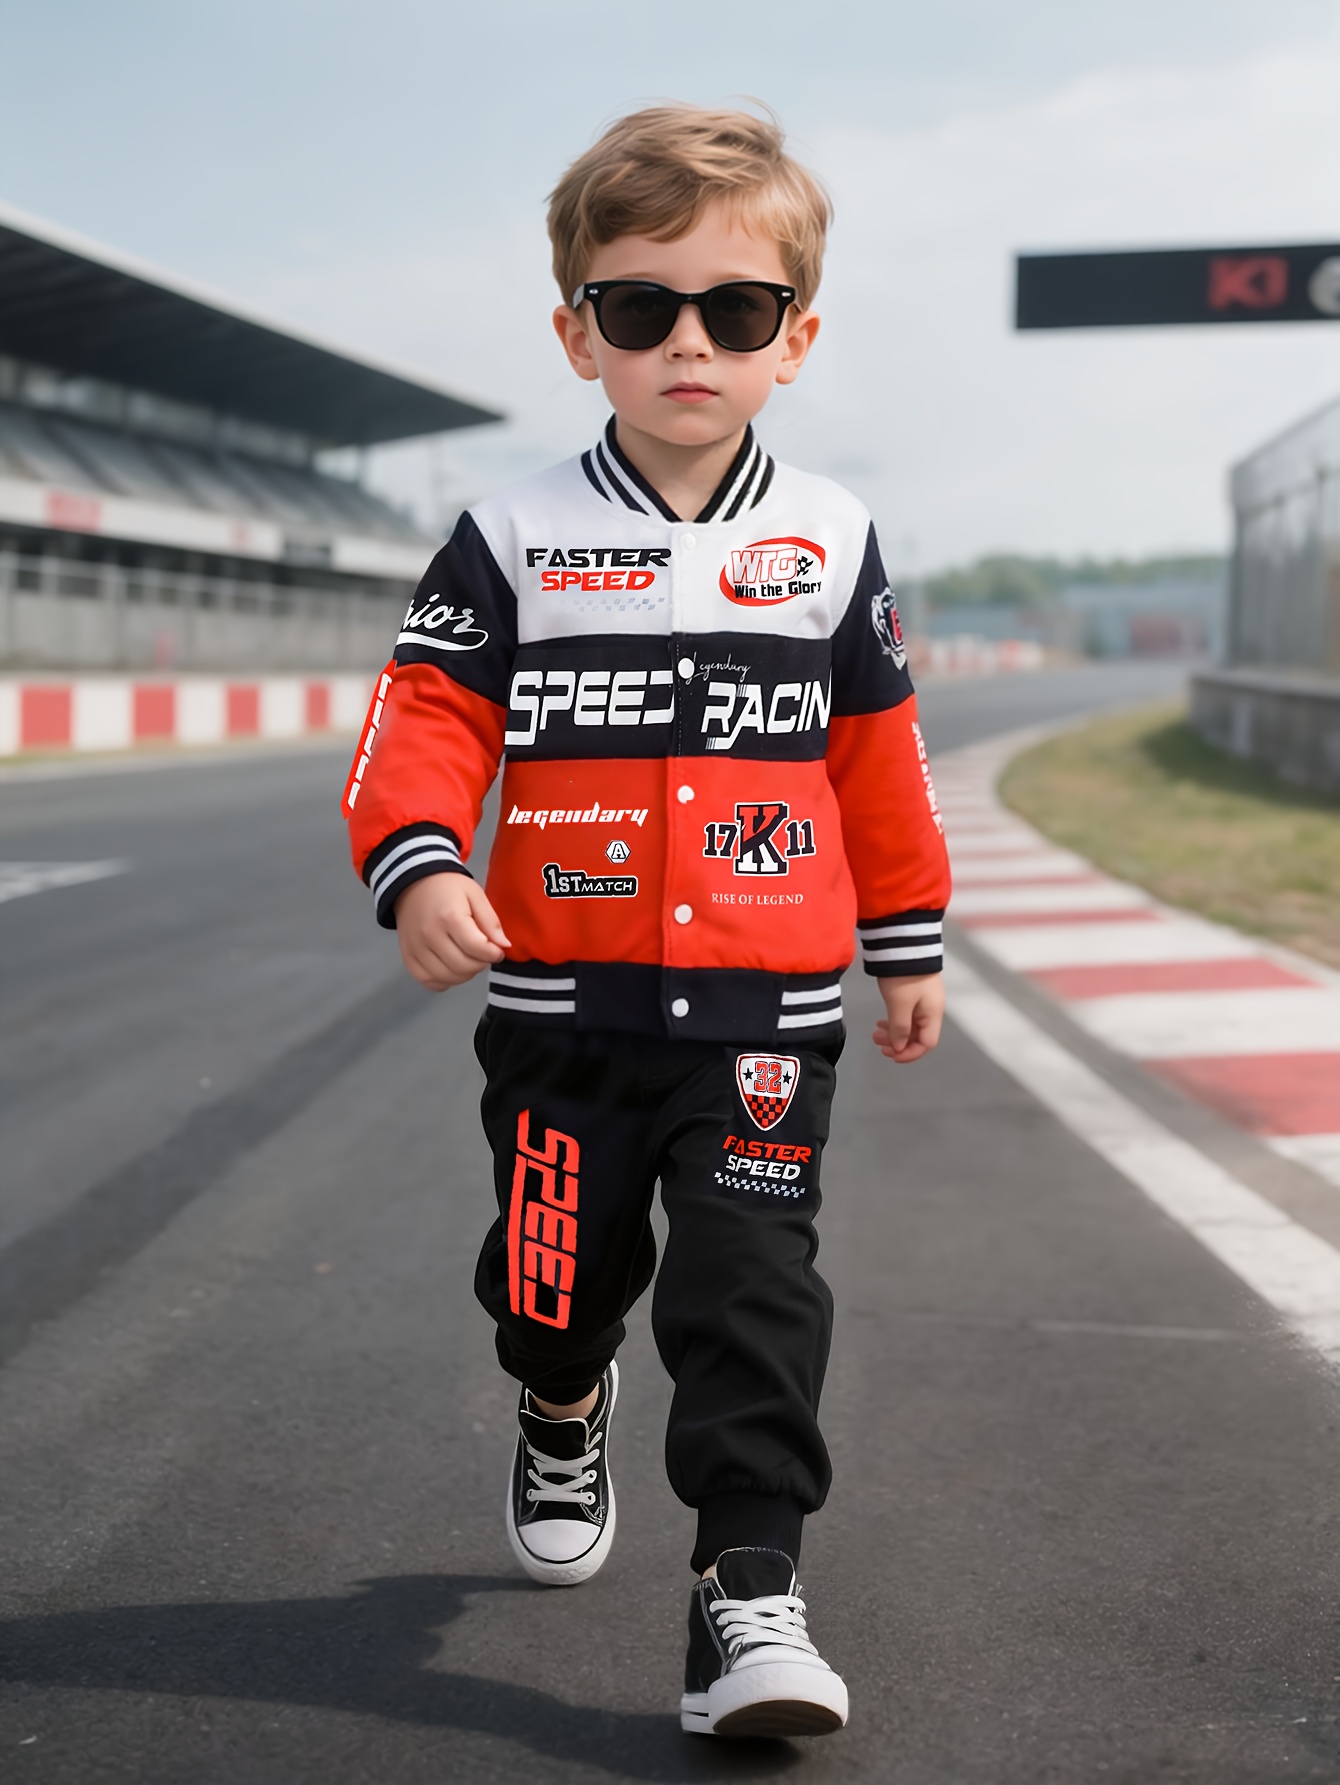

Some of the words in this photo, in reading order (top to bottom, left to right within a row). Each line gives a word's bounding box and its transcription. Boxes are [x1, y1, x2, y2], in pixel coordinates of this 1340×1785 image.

[526, 548, 672, 567] FASTER
[731, 548, 798, 584] WTG
[541, 571, 655, 591] SPEED
[735, 585, 757, 598] Win
[761, 584, 783, 597] the
[788, 581, 822, 595] Glory
[504, 670, 675, 746] SPEED
[700, 665, 832, 750] RACIN
[507, 801, 649, 830] legendary
[703, 822, 738, 858] 17
[733, 801, 789, 876] K
[785, 819, 817, 858] 11
[711, 893, 735, 905] RISE
[738, 893, 753, 905] OF
[757, 893, 804, 905] LEGEND
[753, 1061, 783, 1095] 32
[722, 1135, 812, 1164] FASTER
[726, 1154, 801, 1181] SPEED
[507, 1108, 580, 1330] SPEED
